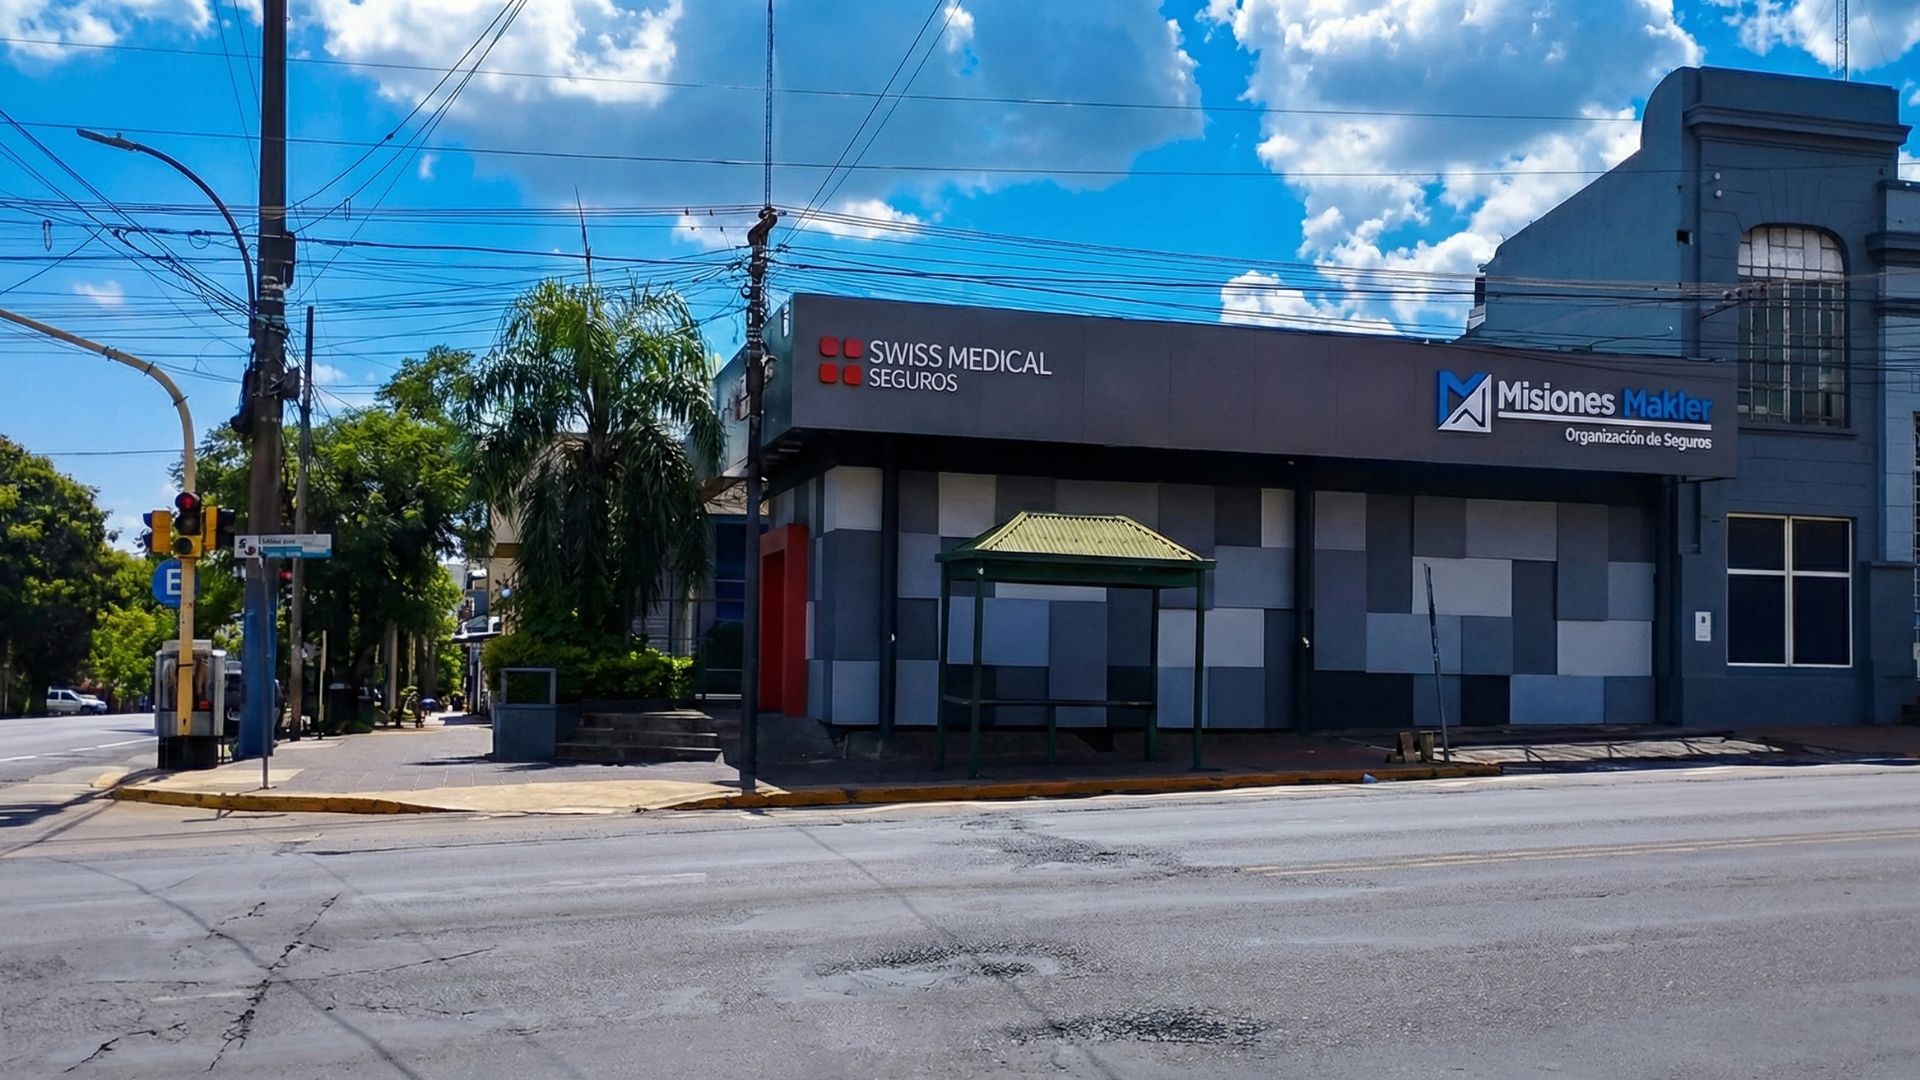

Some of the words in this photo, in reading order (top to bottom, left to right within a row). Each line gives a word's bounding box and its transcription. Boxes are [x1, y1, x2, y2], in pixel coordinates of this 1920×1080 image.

[869, 340, 943, 368] SWISS
[948, 346, 1053, 375] MEDICAL
[869, 368, 958, 392] SEGUROS
[1498, 380, 1616, 415] Misiones
[1622, 387, 1713, 421] Makler
[1565, 426, 1645, 446] Organización
[1646, 432, 1662, 447] de
[1664, 433, 1713, 451] Seguros
[166, 568, 182, 596] E
